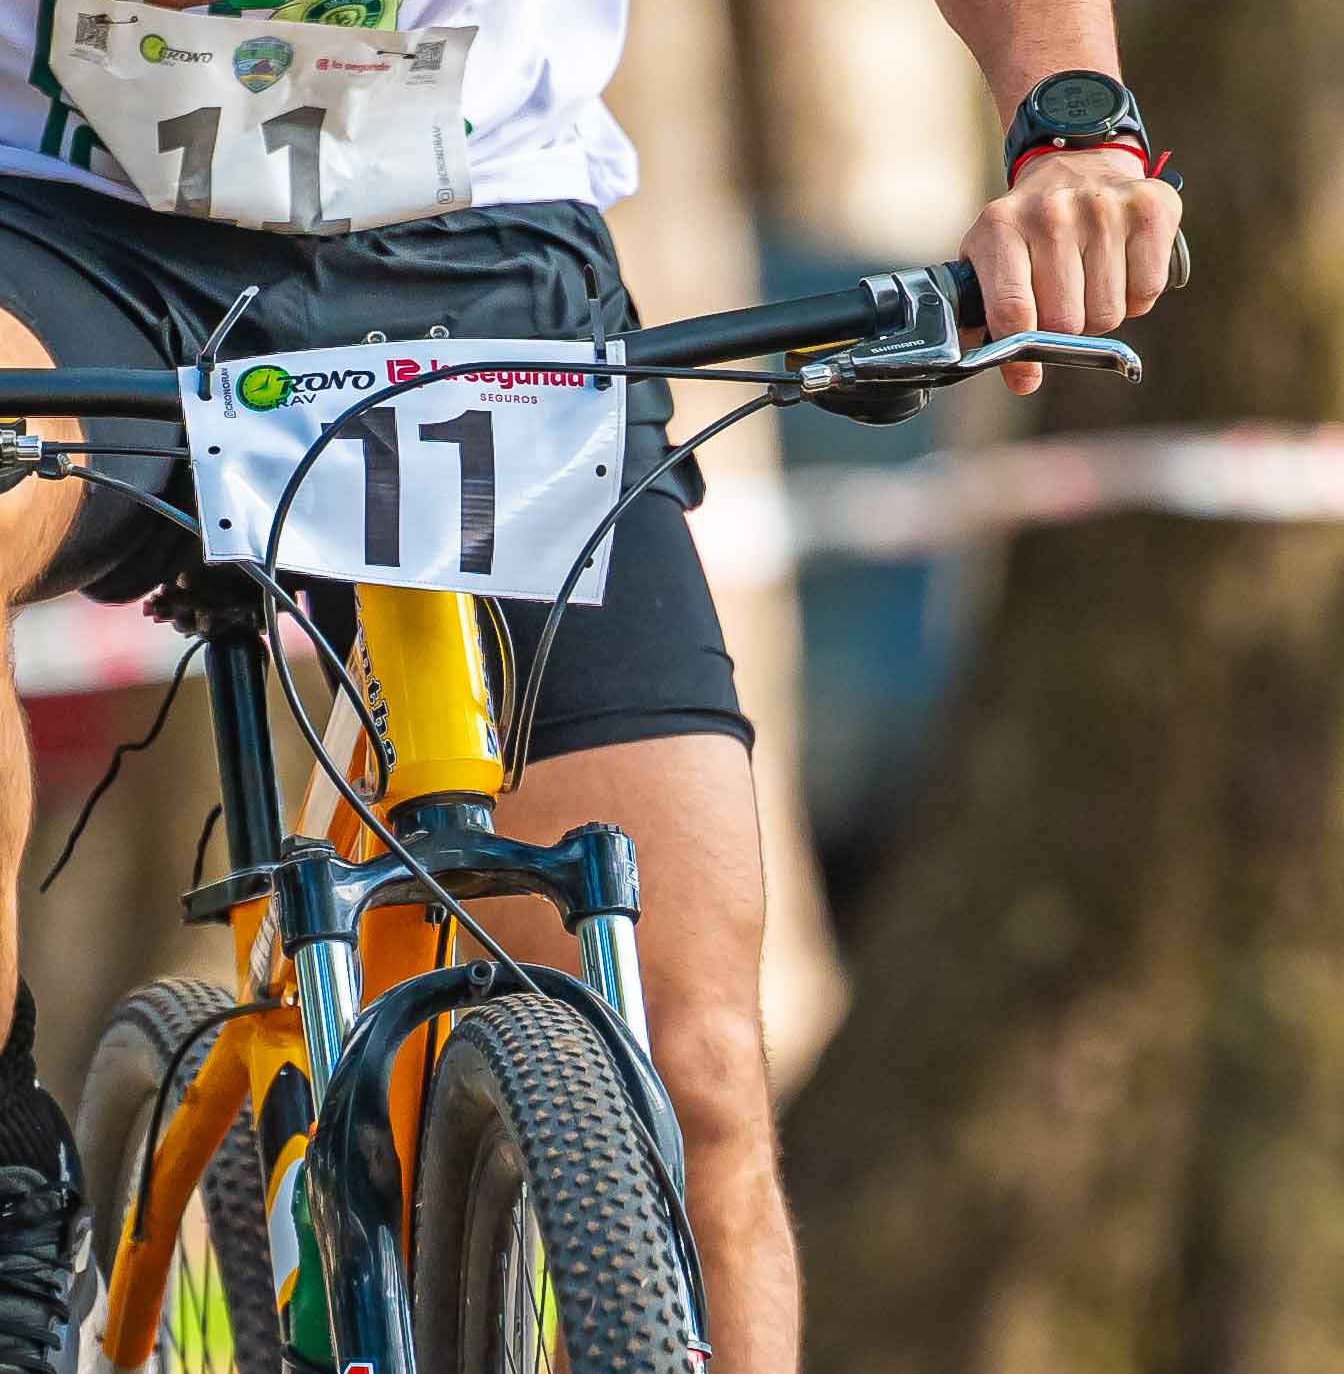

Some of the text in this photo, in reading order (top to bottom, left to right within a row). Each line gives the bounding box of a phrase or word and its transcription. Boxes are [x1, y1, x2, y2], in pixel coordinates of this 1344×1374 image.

[157, 105, 351, 237] 11
[869, 339, 926, 354] SHIMANO
[479, 393, 539, 405] SEGUROS
[320, 406, 495, 576] 11
